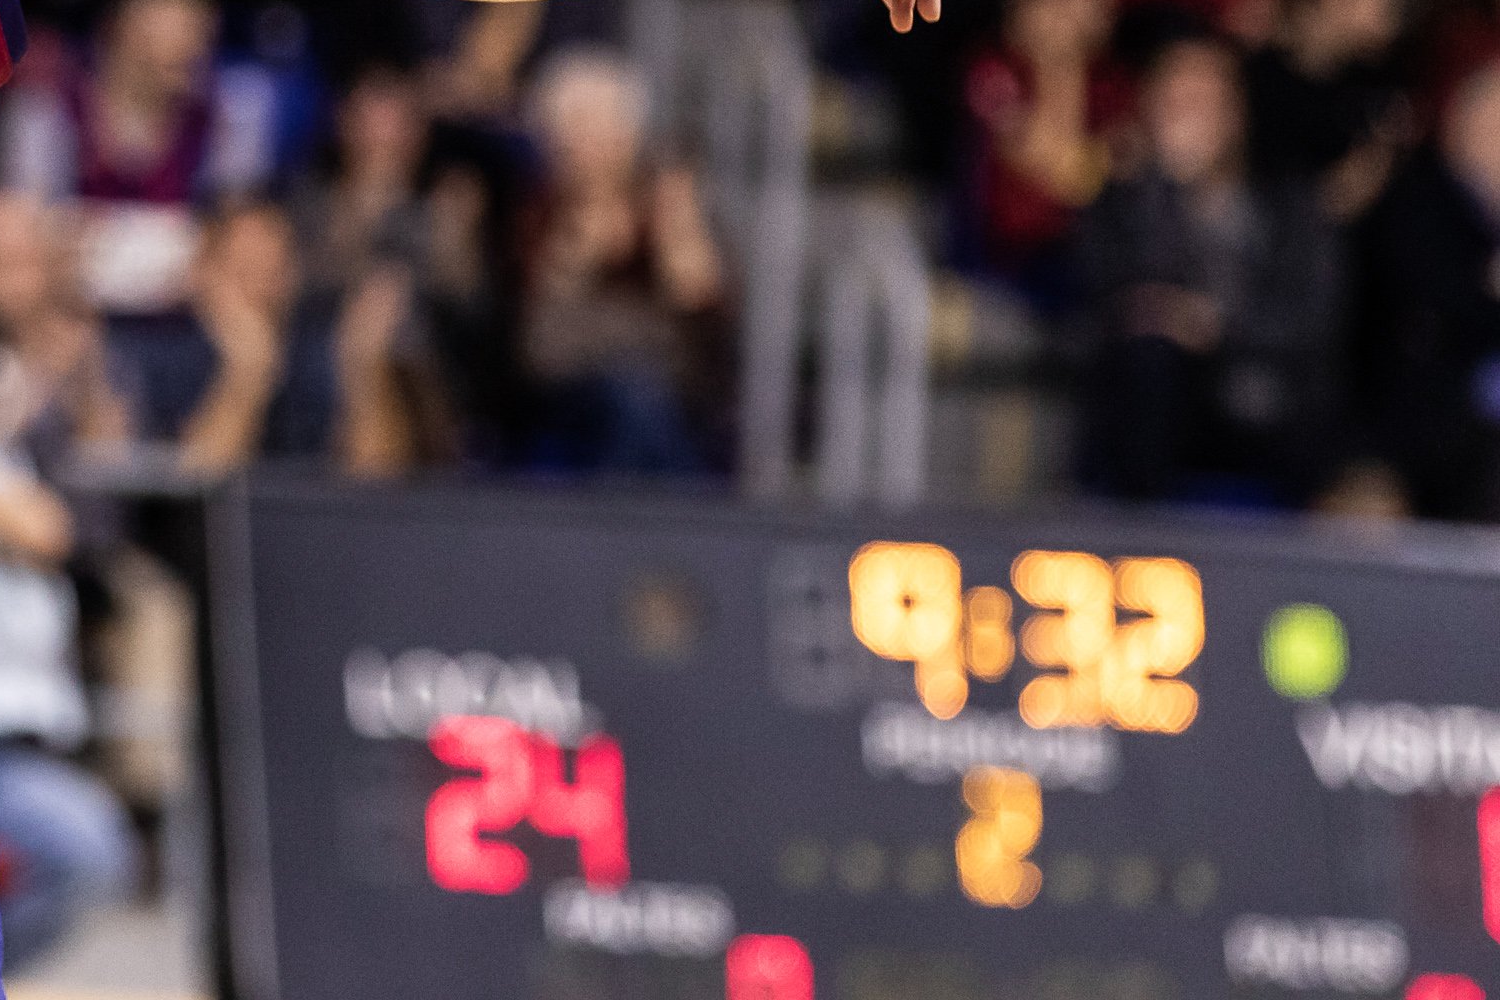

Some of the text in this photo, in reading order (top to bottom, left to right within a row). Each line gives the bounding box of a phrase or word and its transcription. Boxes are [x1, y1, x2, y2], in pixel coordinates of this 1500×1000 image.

[848, 540, 1205, 735] 9:32
[424, 713, 631, 895] 24
[955, 765, 1043, 908] 2
